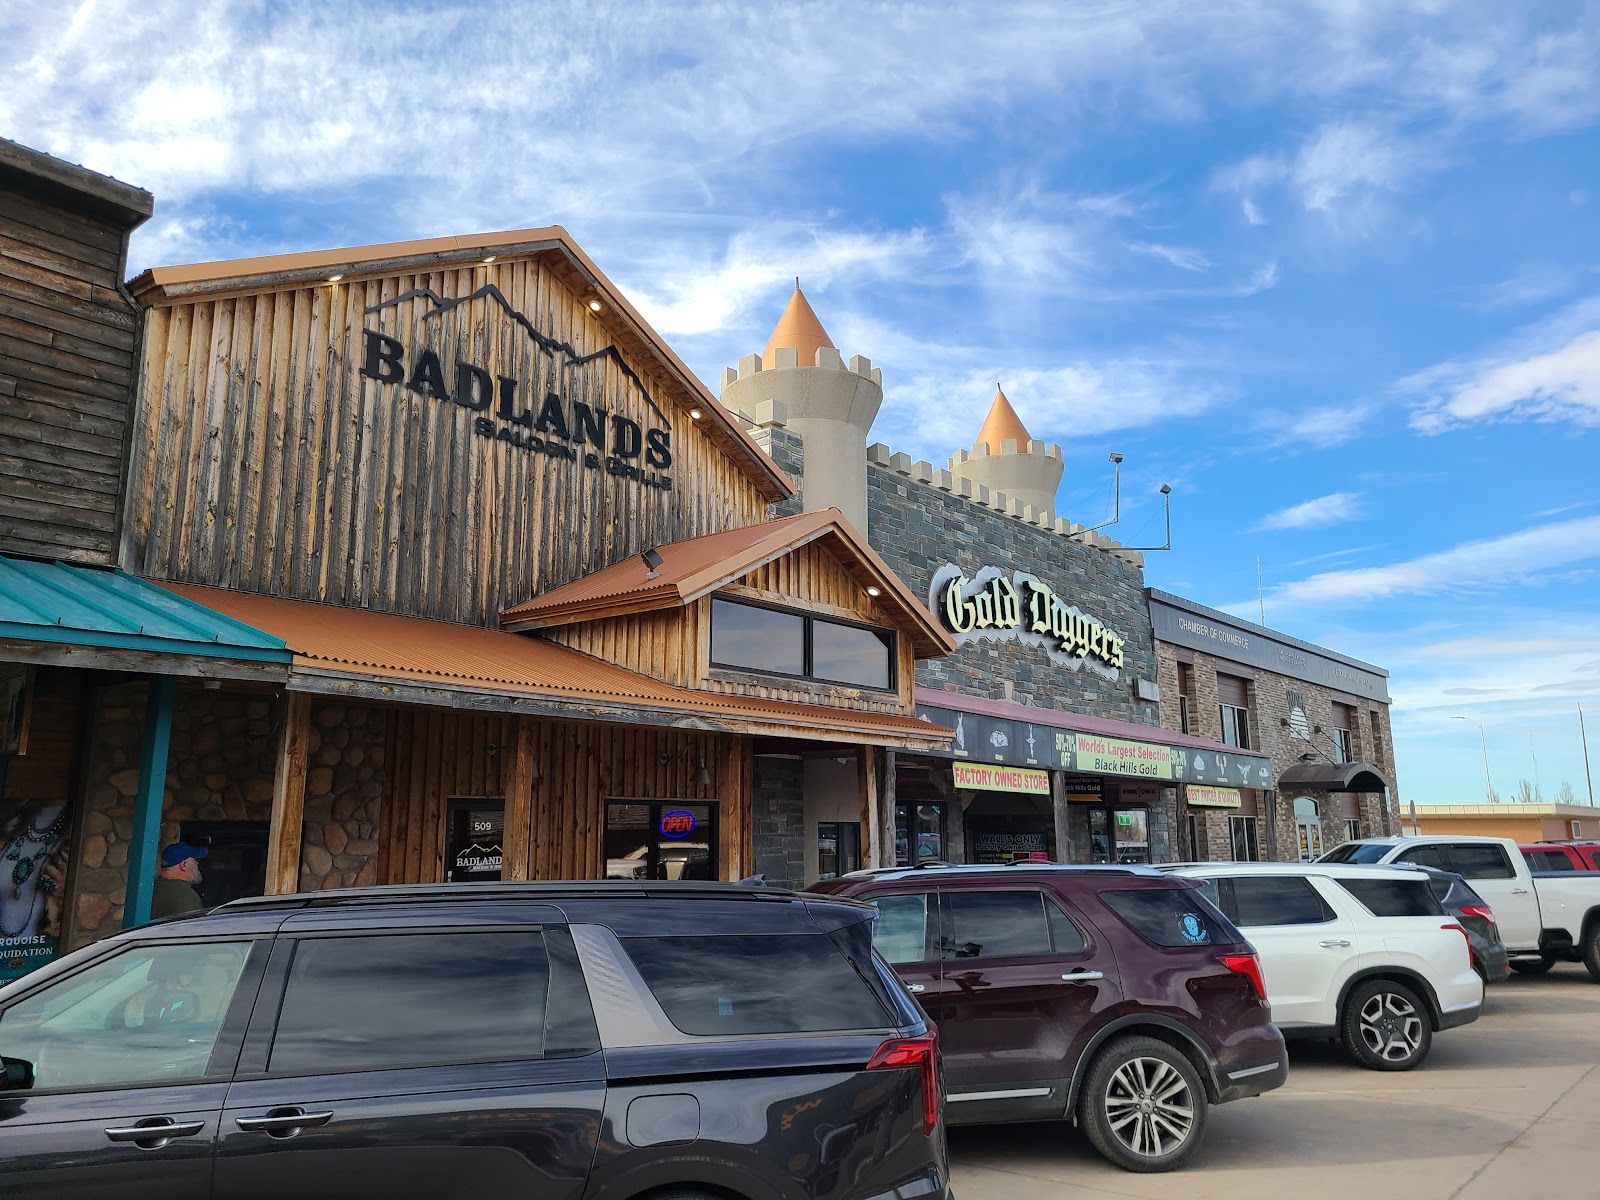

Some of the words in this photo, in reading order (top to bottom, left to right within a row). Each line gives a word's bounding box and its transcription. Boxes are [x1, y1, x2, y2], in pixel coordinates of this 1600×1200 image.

[360, 327, 672, 469] BADLANDS
[475, 416, 577, 462] SALOON
[605, 456, 672, 491] GRILLE
[944, 575, 1021, 633] Gold
[1026, 580, 1125, 669] Diggers
[1178, 617, 1210, 637] CHAMBER
[1209, 627, 1218, 639] OF
[1218, 630, 1249, 650] COMMERCE
[1060, 752, 1071, 768] OFF
[1078, 737, 1106, 754] World's
[1107, 742, 1136, 760] Largest
[1138, 747, 1170, 762] Selection
[954, 766, 992, 785] FACTORY
[994, 771, 1022, 788] OWNED
[1024, 773, 1048, 790] STORE
[1094, 758, 1118, 772] Black
[1119, 761, 1137, 774] Hills
[1139, 763, 1158, 776] Gold
[474, 822, 492, 831] 509
[661, 815, 693, 832] OPEN
[1013, 834, 1041, 845] ONLY
